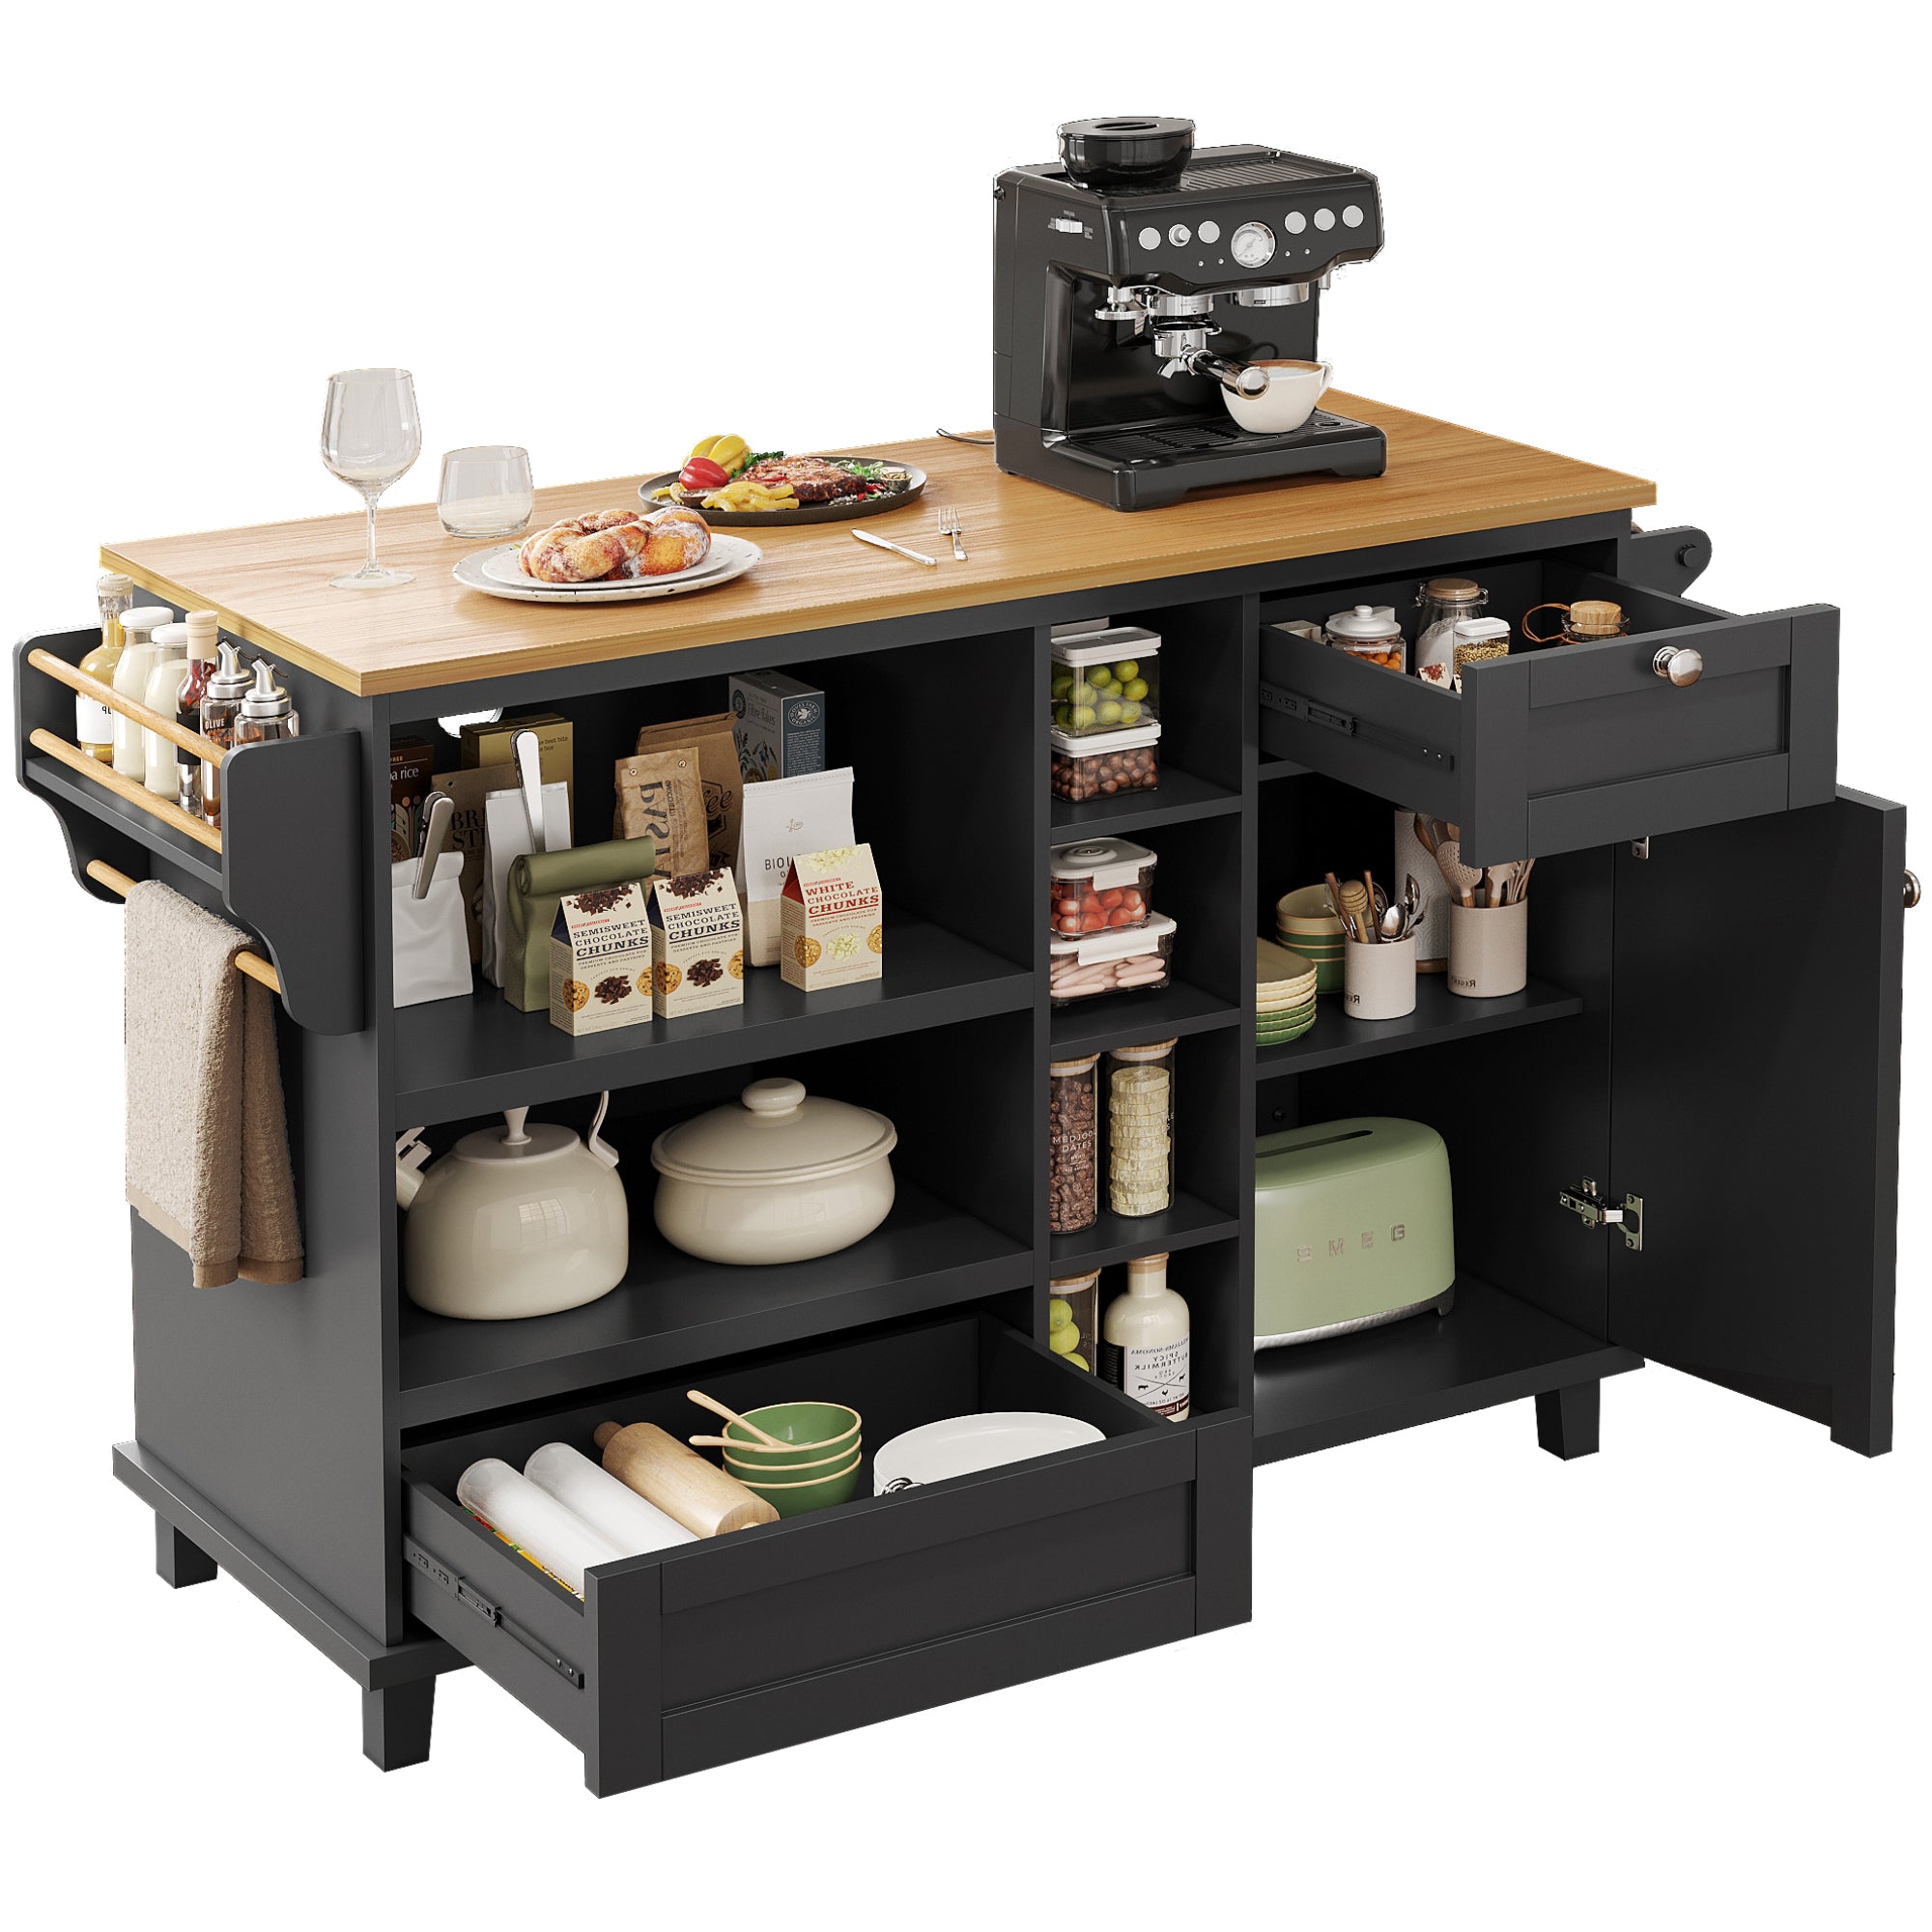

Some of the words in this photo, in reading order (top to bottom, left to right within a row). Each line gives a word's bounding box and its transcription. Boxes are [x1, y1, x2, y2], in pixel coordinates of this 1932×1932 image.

[205, 718, 225, 730] OLIVE
[400, 766, 419, 781] rice
[805, 881, 855, 896] WHITE
[808, 886, 878, 905] CHOCOLATE
[666, 903, 737, 923] SEMISWEET
[809, 895, 879, 915] CHUNKS
[573, 920, 646, 939] SEMISWEET
[668, 911, 740, 930] CHOCOLATE
[668, 920, 741, 940] CHUNKS
[575, 927, 648, 947] CHOCOLATE
[576, 936, 649, 956] CHUNKS
[1063, 1140, 1093, 1152] DATES
[1296, 1224, 1406, 1264] SMEG
